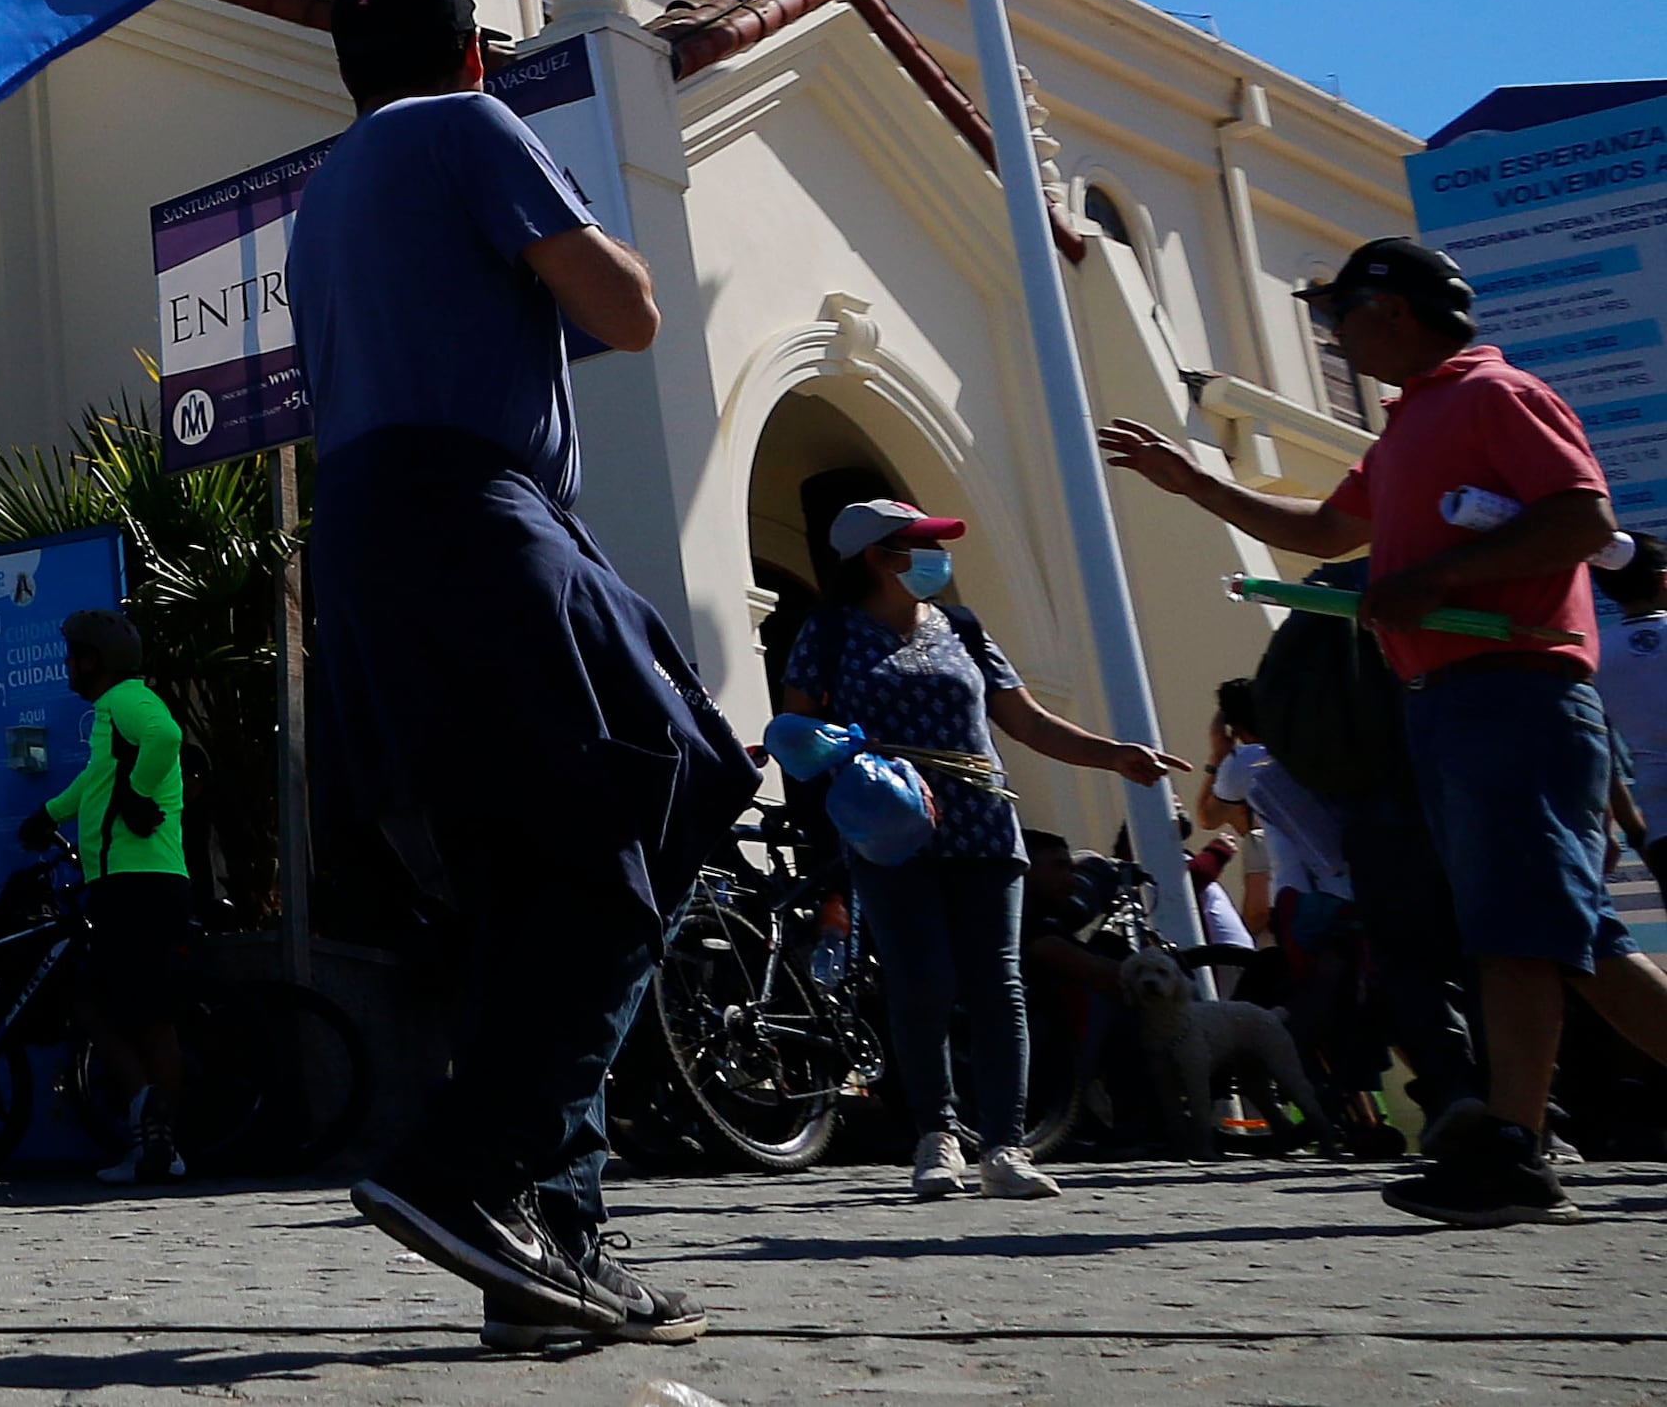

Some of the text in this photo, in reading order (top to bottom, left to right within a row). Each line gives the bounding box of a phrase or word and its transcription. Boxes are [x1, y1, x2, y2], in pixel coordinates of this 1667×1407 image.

[162, 184, 241, 225] SANTUARIO
[242, 160, 307, 194] NUESTRA
[1433, 126, 1667, 193] CON ESPERANZA
[1494, 160, 1646, 207] VOLVEMOS
[170, 271, 289, 344] ENTR
